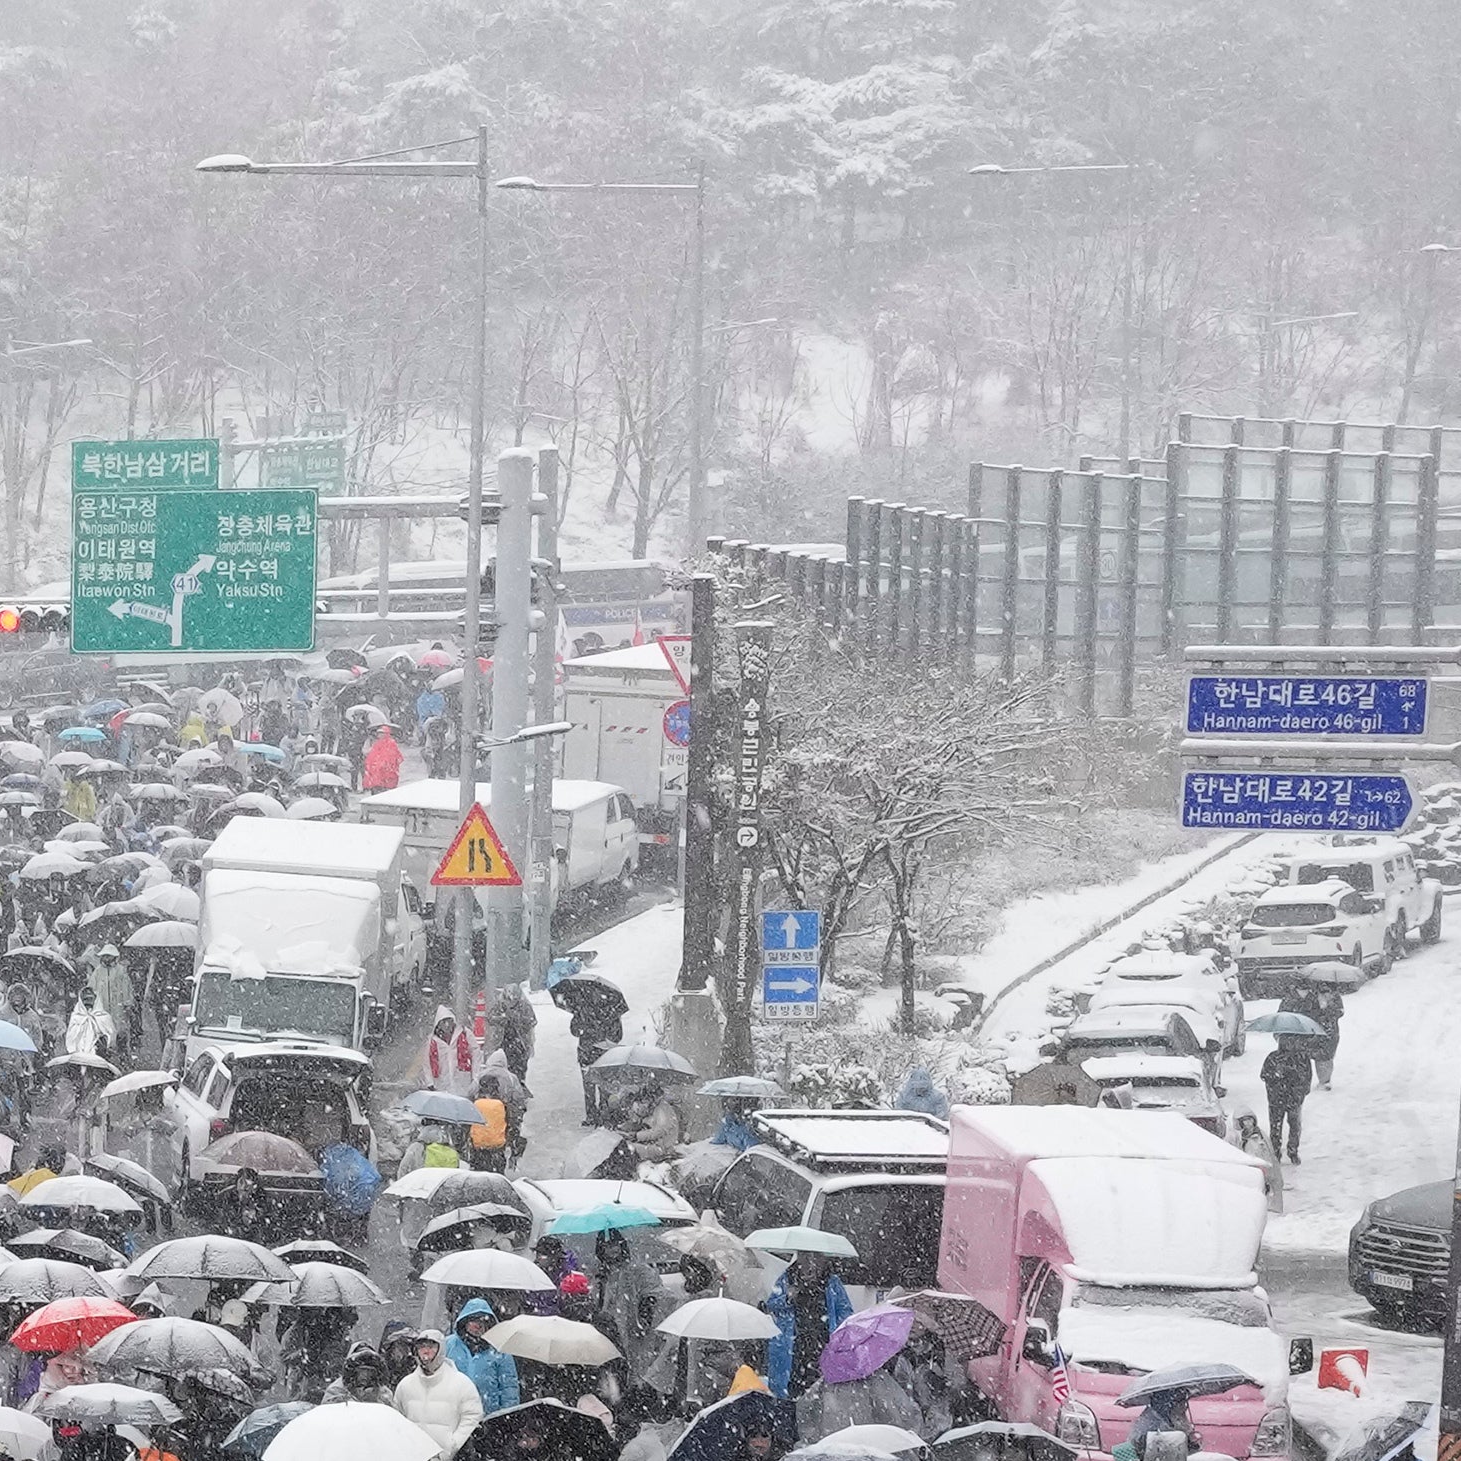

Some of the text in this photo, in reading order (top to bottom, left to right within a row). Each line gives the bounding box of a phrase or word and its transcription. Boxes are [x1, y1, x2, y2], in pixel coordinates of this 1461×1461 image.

[78, 496, 157, 519] 용산구청
[216, 514, 314, 538] 장충체육관
[78, 537, 157, 560] 이태원역
[216, 539, 291, 555] Jangchung Arena
[216, 558, 280, 581] 약수역
[77, 583, 156, 598] Itaewon Stn
[175, 575, 197, 592] 41
[216, 582, 284, 598] Yaksu Stn
[605, 607, 637, 619] POLICE
[1213, 681, 1377, 709] 한남대로46길
[1203, 711, 1330, 730] Hannam-daero
[1333, 713, 1383, 733] 46-gil
[666, 753, 689, 766] 견인
[1191, 776, 1353, 806] 한남대로42길
[1384, 790, 1402, 804] 62
[1187, 806, 1381, 830] Hannam-daero 42-gil
[767, 951, 815, 962] 일방통행
[736, 981, 746, 1003] Park
[767, 1005, 815, 1017] 일방통행
